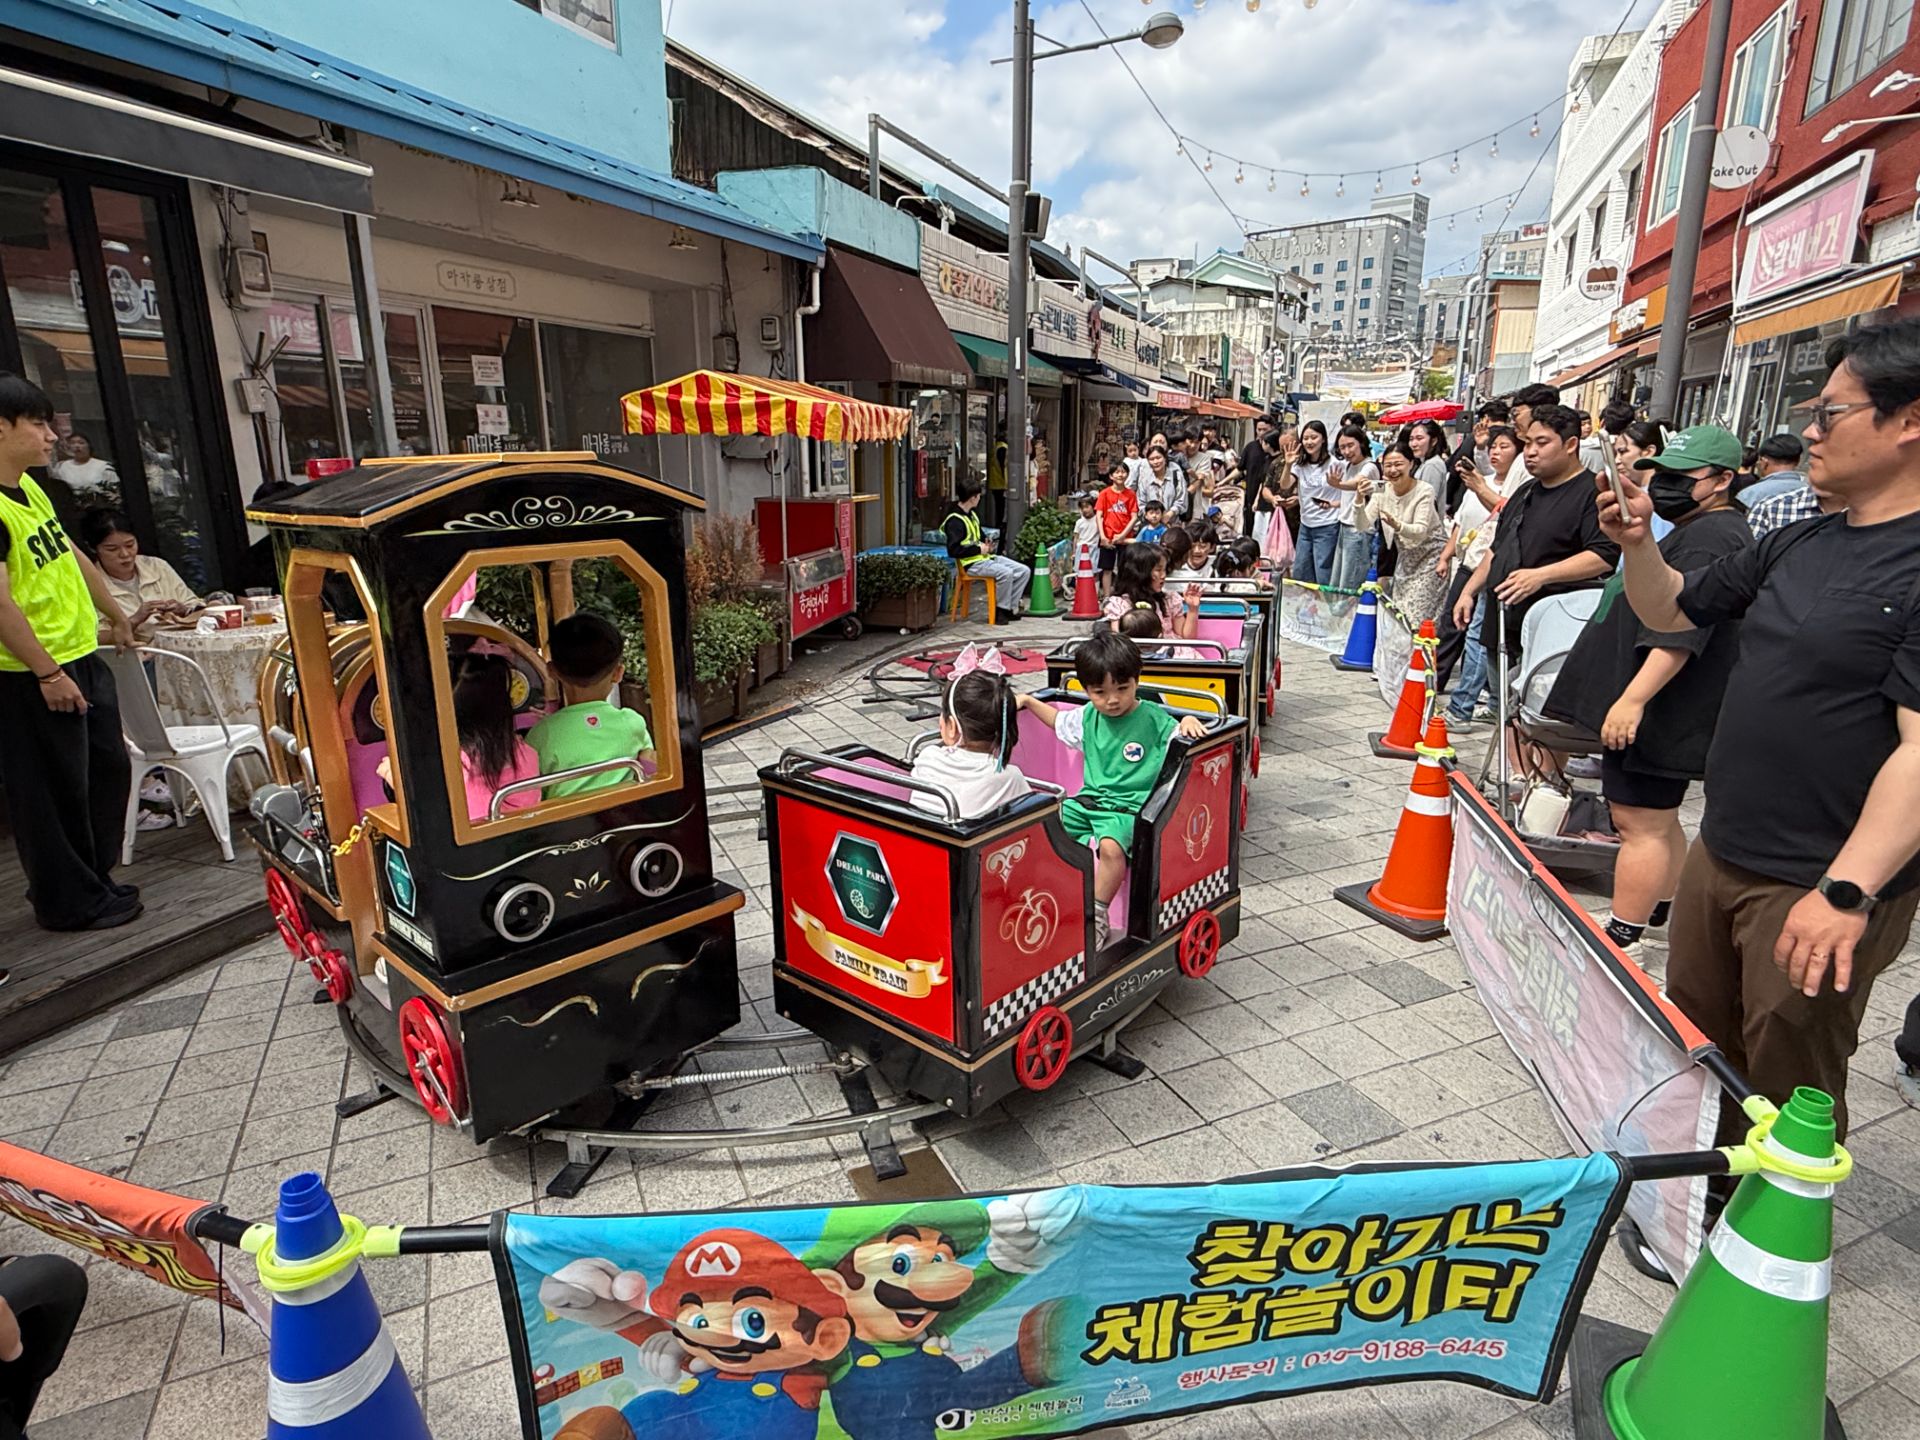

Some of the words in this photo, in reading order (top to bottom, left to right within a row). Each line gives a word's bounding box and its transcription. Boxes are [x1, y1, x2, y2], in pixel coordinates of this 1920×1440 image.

[1712, 166, 1733, 177] ake
[1736, 165, 1758, 176] Out
[1246, 245, 1289, 261] HOTEL
[1293, 240, 1329, 258] AURA
[27, 516, 70, 570] SAF
[836, 858, 863, 876] DREAM
[866, 869, 887, 885] PARK
[835, 949, 871, 977] FAMILY
[873, 966, 908, 992] TRAIN
[1190, 1200, 1562, 1287] 찾아가는
[1083, 1262, 1536, 1363] 체험놀이터
[1179, 1359, 1276, 1388] 행사문의
